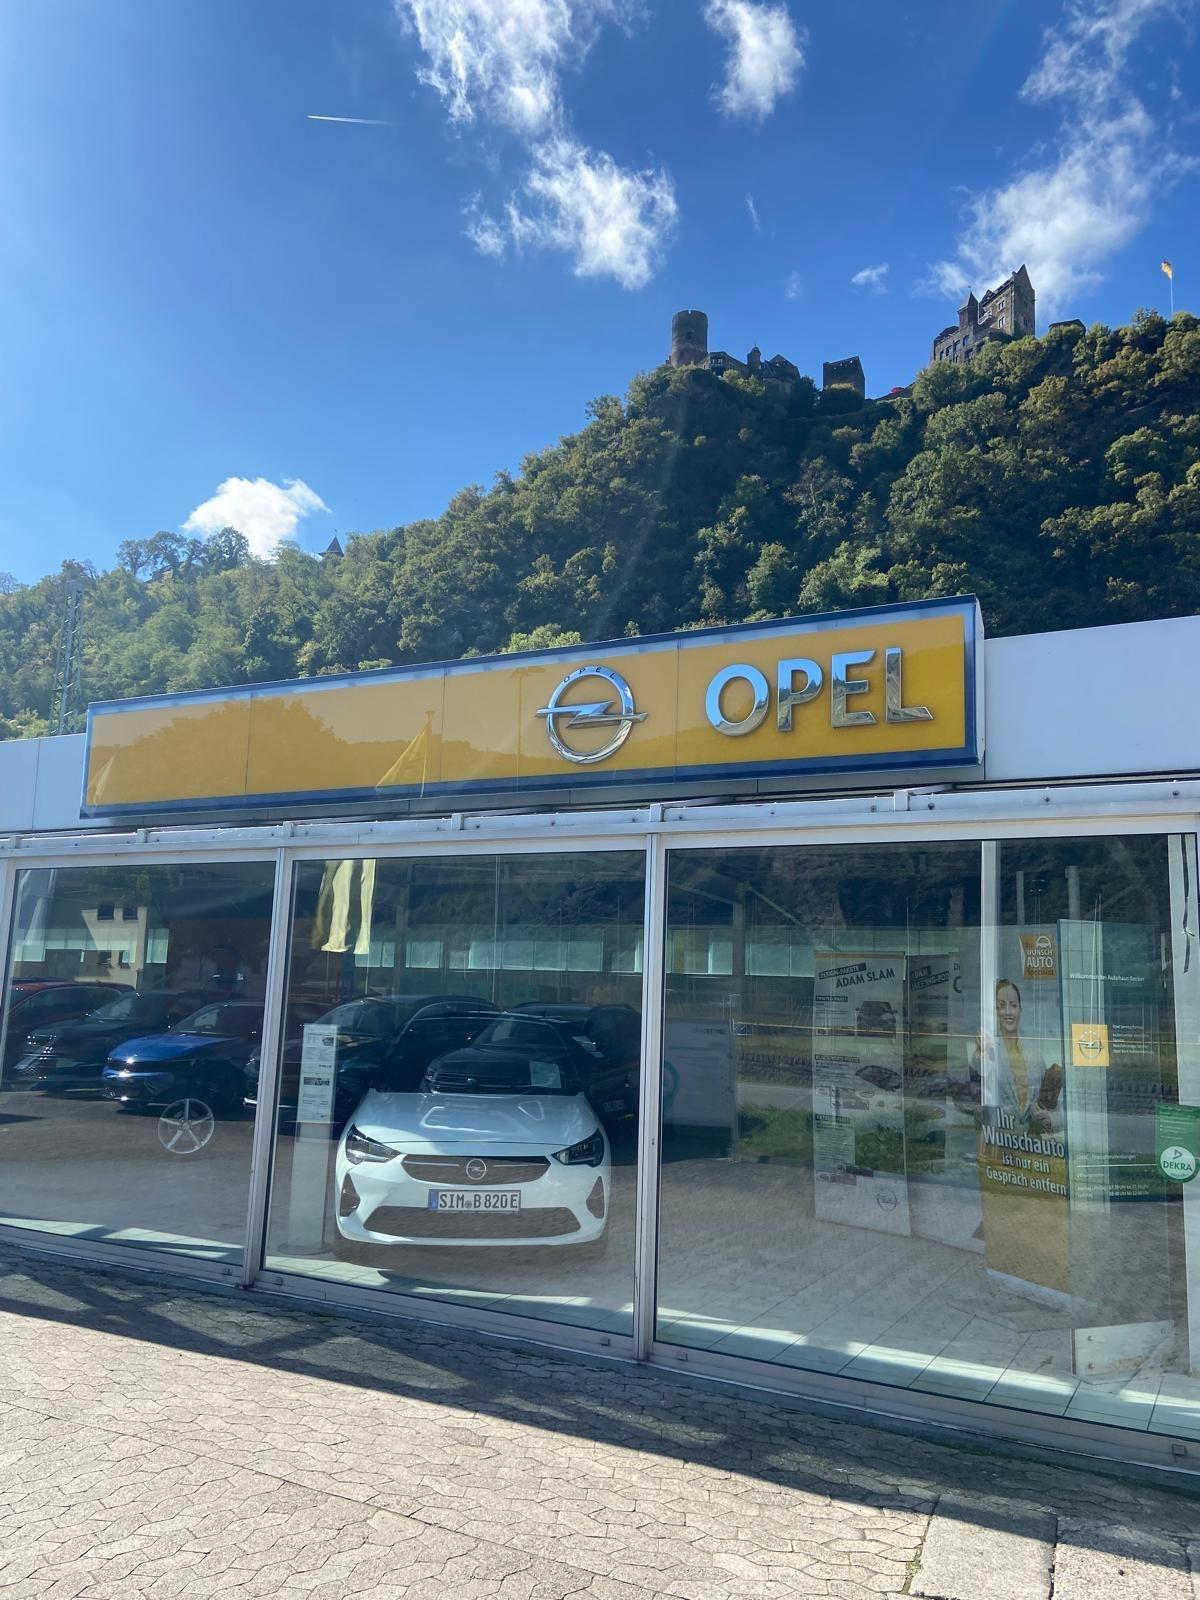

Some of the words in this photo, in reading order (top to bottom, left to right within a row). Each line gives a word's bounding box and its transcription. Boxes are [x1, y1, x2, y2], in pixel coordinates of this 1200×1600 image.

[563, 666, 616, 683] OPEL
[706, 647, 934, 737] OPEL
[1027, 956, 1053, 968] AUTO
[836, 973, 865, 989] ADAM
[867, 968, 896, 982] SLAM
[997, 1108, 1015, 1130] Ihr
[982, 1124, 1065, 1158] Wunschauto
[1002, 1152, 1013, 1166] ist
[1016, 1156, 1031, 1170] nur
[1033, 1158, 1050, 1174] ein
[1163, 1160, 1193, 1172] DEKRA
[986, 1165, 1028, 1187] Gespräch
[439, 1193, 465, 1209] SIM
